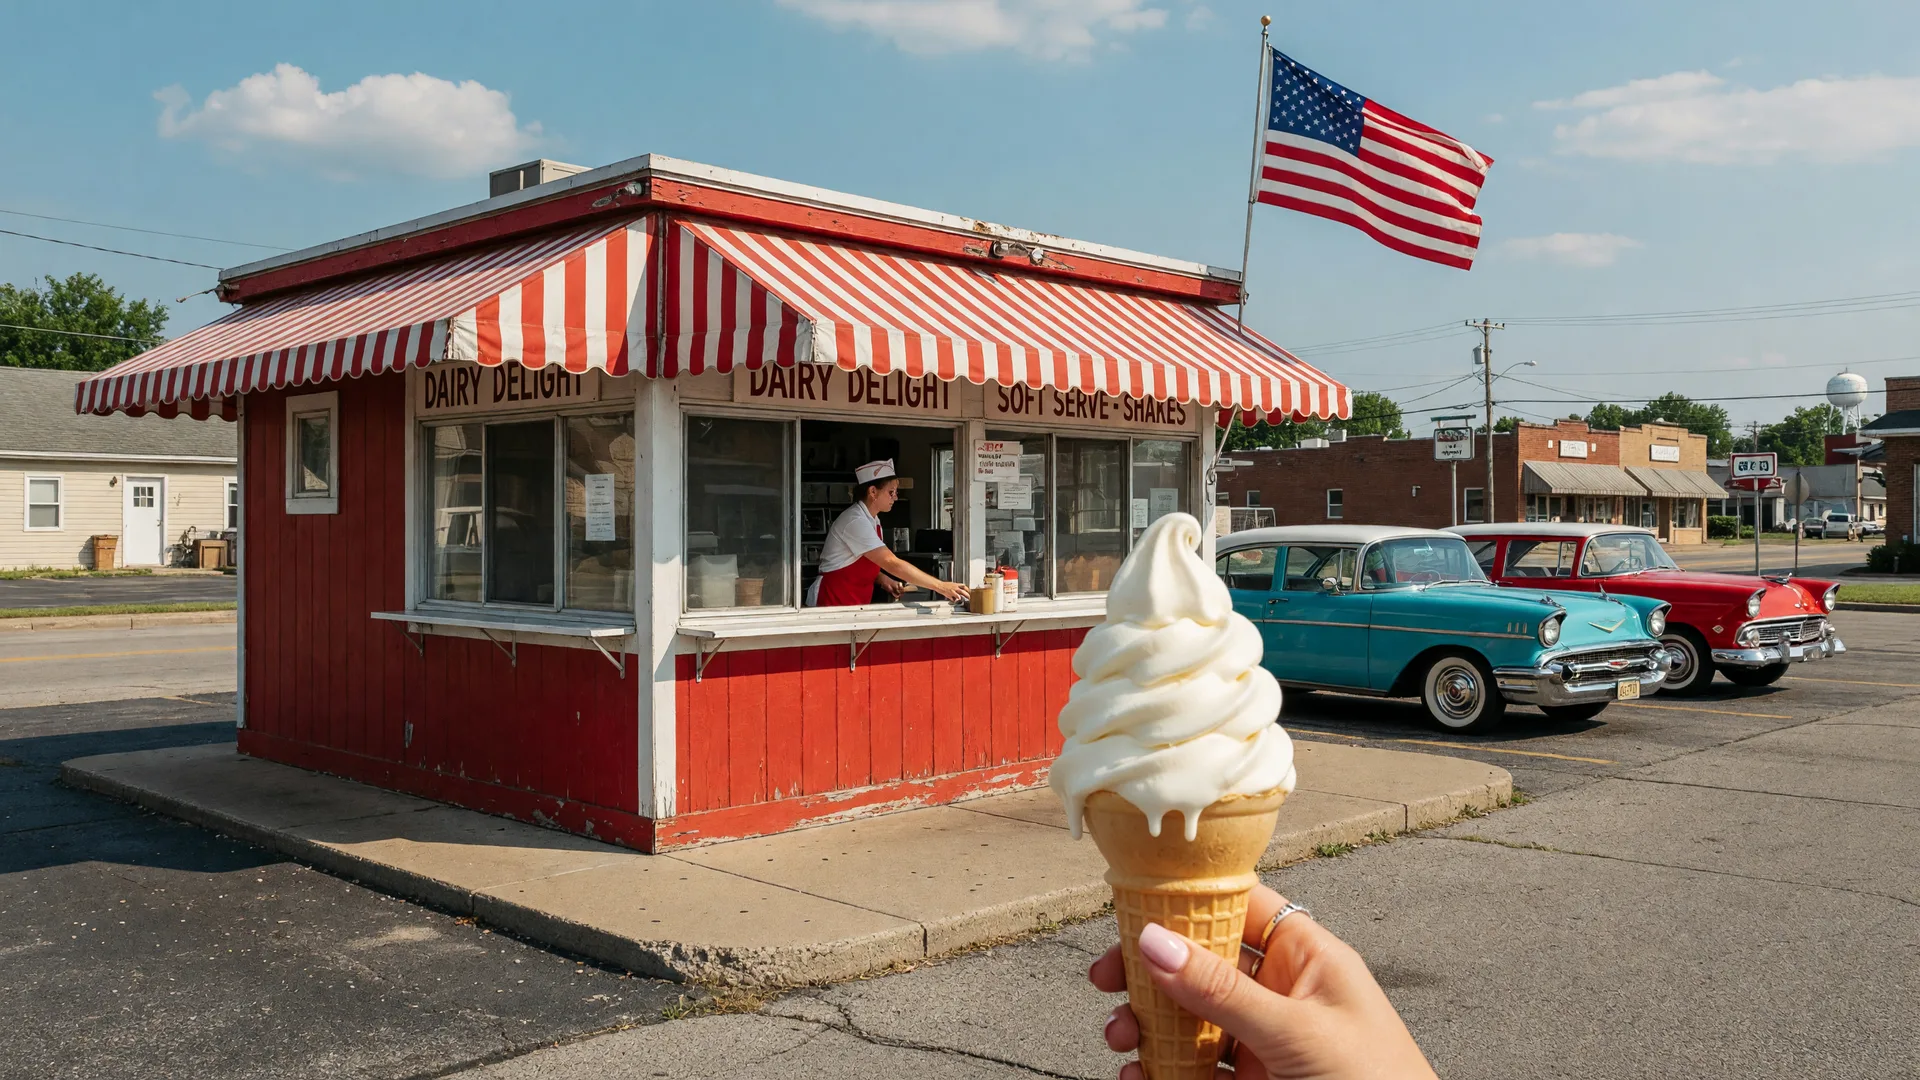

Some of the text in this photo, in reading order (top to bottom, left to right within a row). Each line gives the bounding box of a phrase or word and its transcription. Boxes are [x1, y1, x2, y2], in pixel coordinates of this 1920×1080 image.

[425, 365, 484, 409] DAIRY
[750, 362, 834, 401] DAIRY
[997, 384, 1187, 426] SOFT SERVE SHAKES
